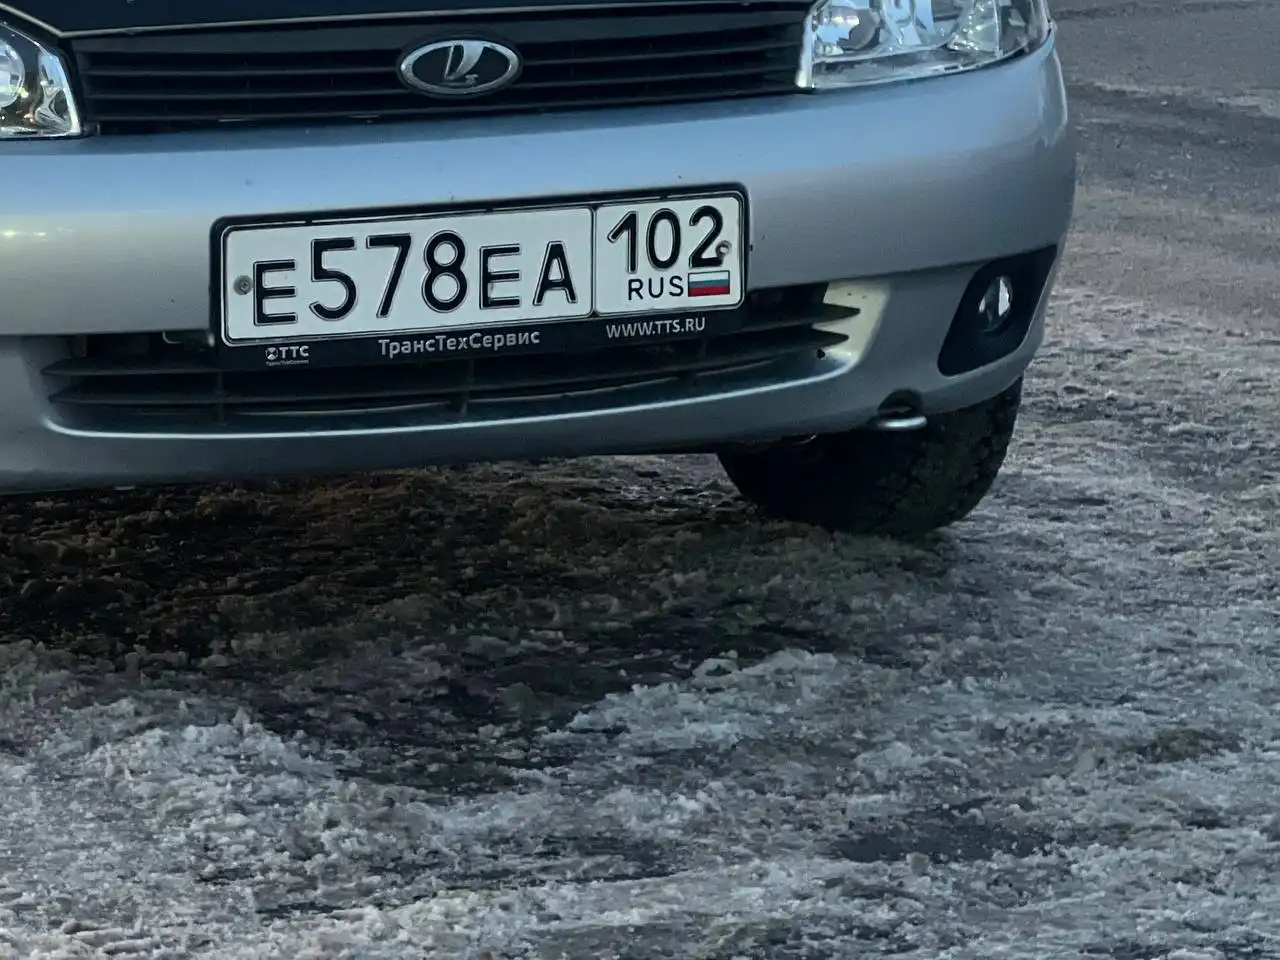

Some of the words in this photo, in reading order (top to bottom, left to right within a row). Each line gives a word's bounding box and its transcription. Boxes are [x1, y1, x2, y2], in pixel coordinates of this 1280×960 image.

[607, 205, 724, 273] 102
[253, 230, 578, 326] Е578ЕА
[628, 275, 685, 301] RUS
[606, 317, 706, 339] WWW.TTS.RU
[279, 345, 310, 359] ТТС
[378, 330, 541, 359] ТрансТехСервис
